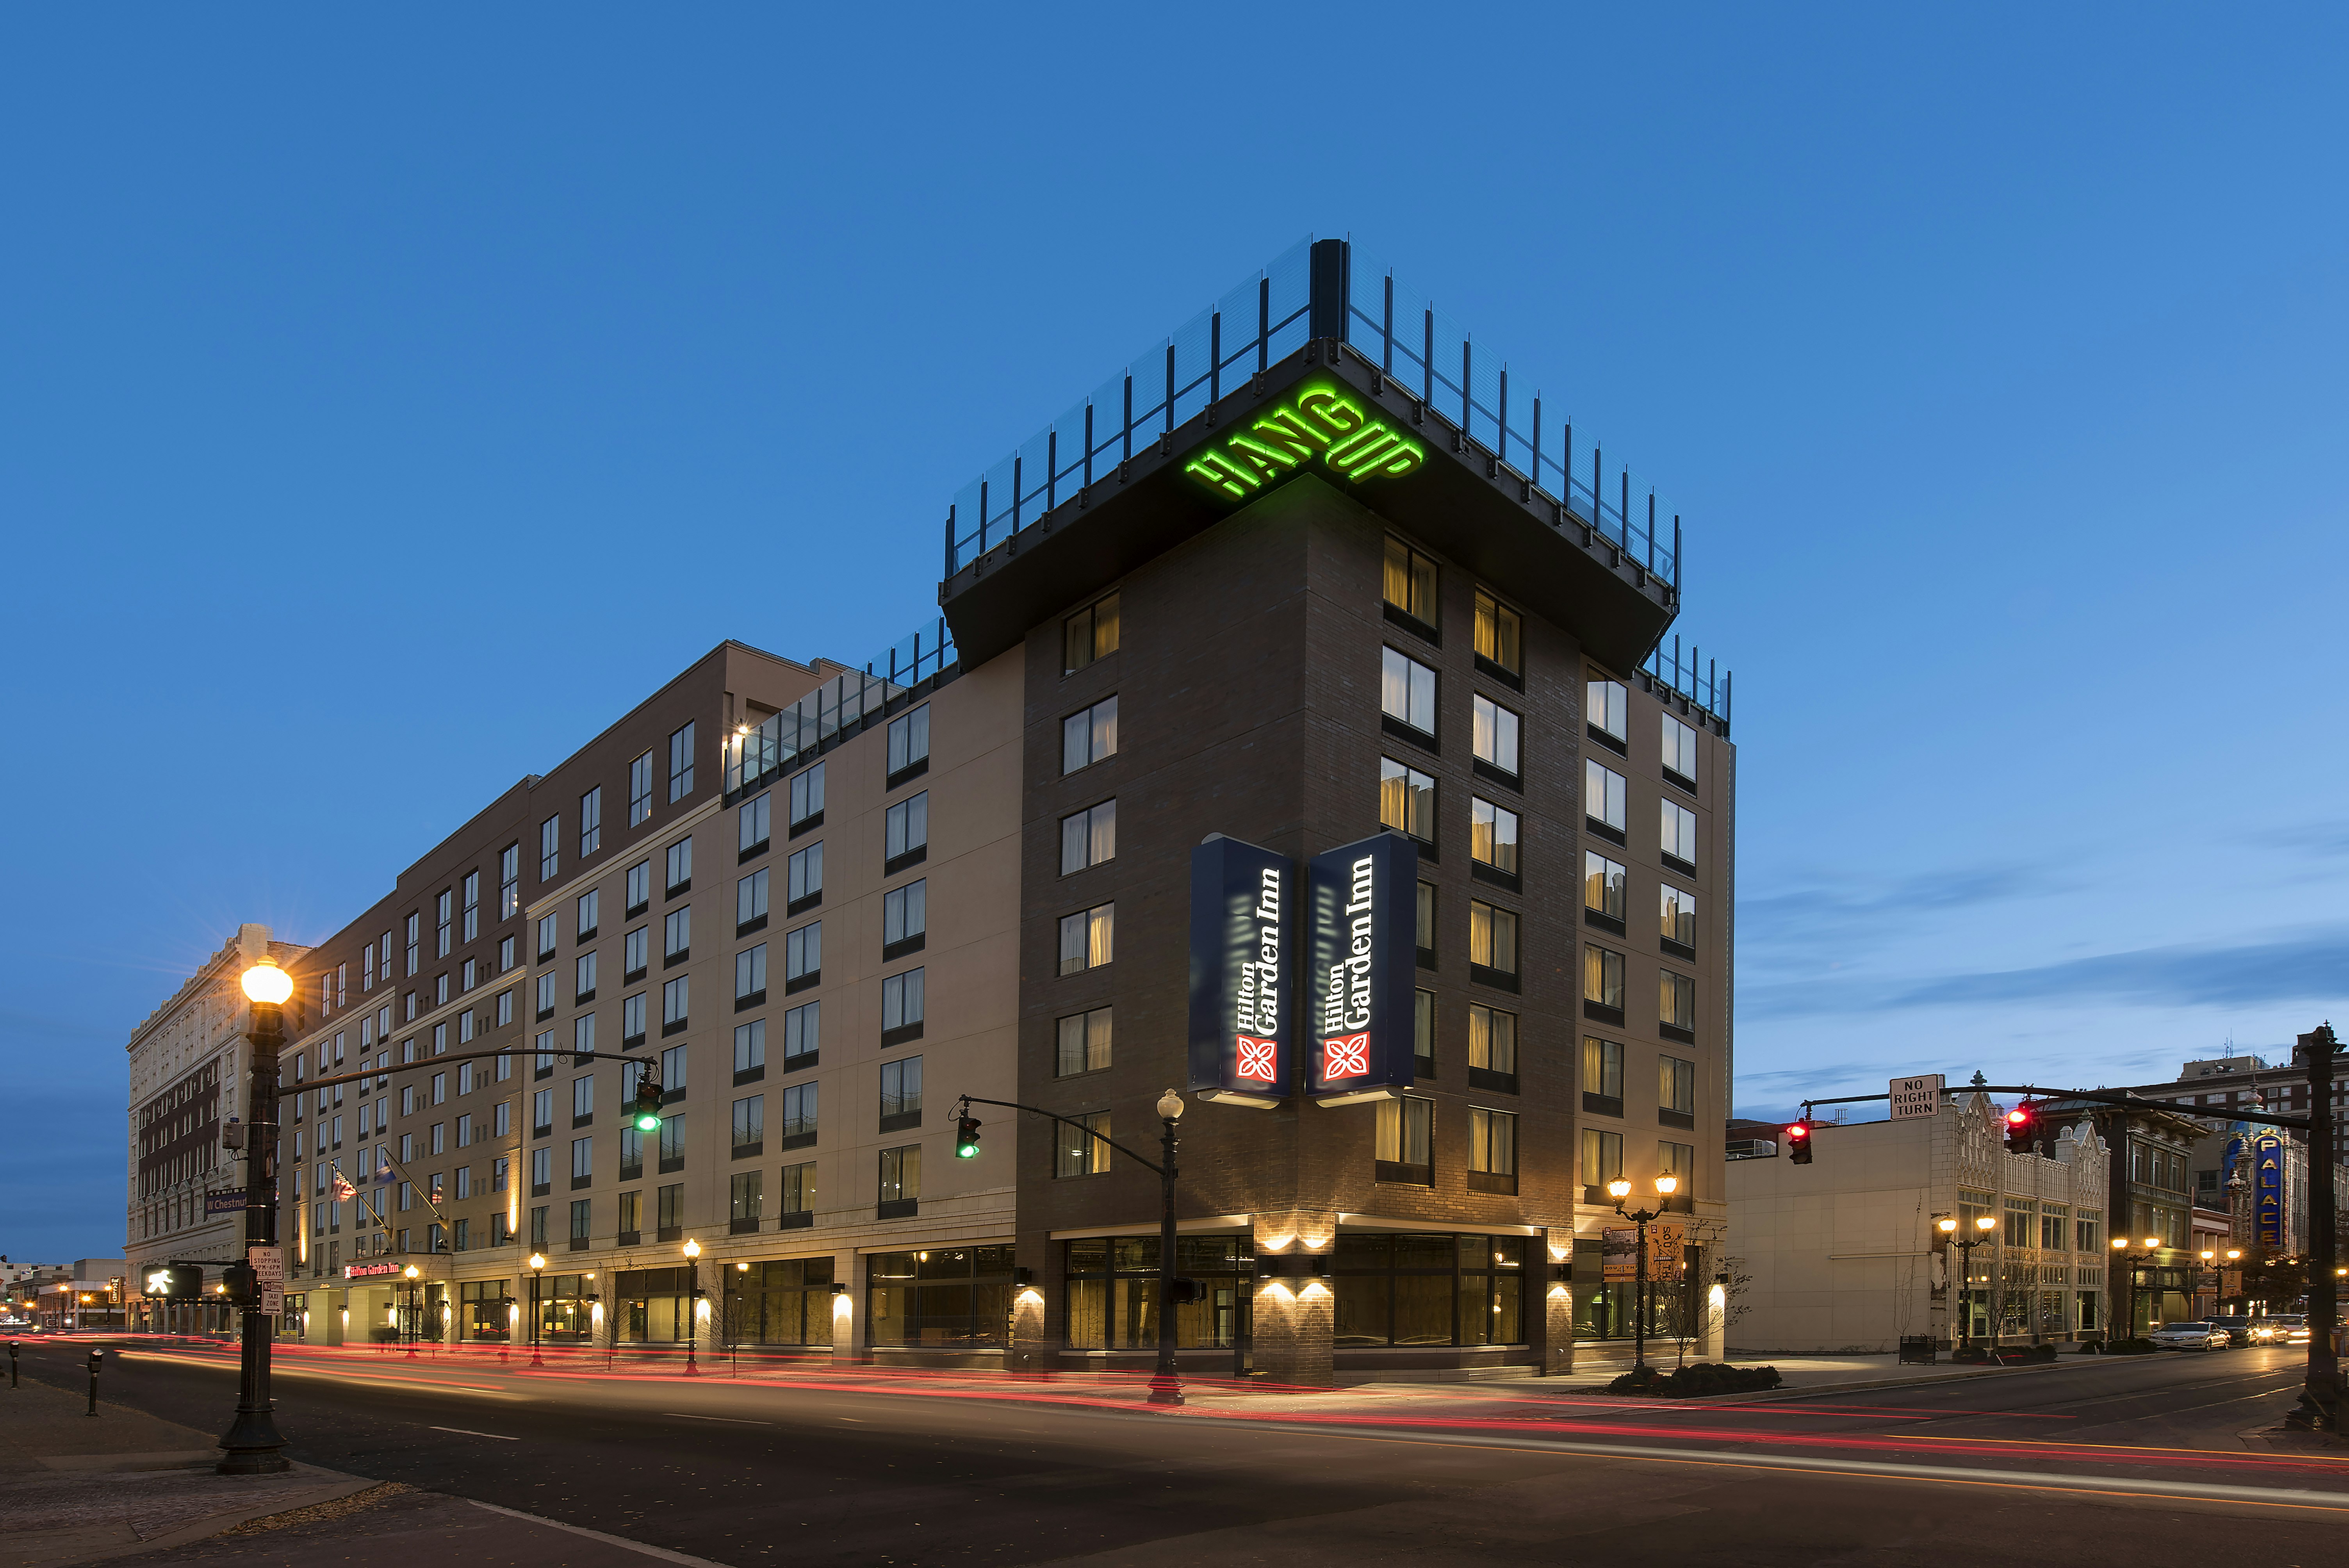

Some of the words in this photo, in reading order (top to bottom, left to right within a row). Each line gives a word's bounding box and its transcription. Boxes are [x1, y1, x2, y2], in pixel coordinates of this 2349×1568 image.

[1185, 388, 1364, 502] HANG
[1325, 420, 1424, 485] UP
[1256, 867, 1280, 923] Inn
[1346, 853, 1373, 916] Inn
[1237, 961, 1255, 1032] Hilton
[1254, 926, 1280, 1036] Garden
[1325, 962, 1346, 1035] Hilton
[1343, 913, 1372, 1030] Garden
[1894, 1090, 1936, 1104] RIGHT
[1897, 1103, 1932, 1115] TURN
[1905, 1080, 1923, 1091] NO
[207, 1201, 214, 1210] W
[2261, 1140, 2278, 1242] PALACE
[351, 1266, 367, 1277] Hilton
[368, 1264, 388, 1275] Garden
[388, 1262, 399, 1273] Inn
